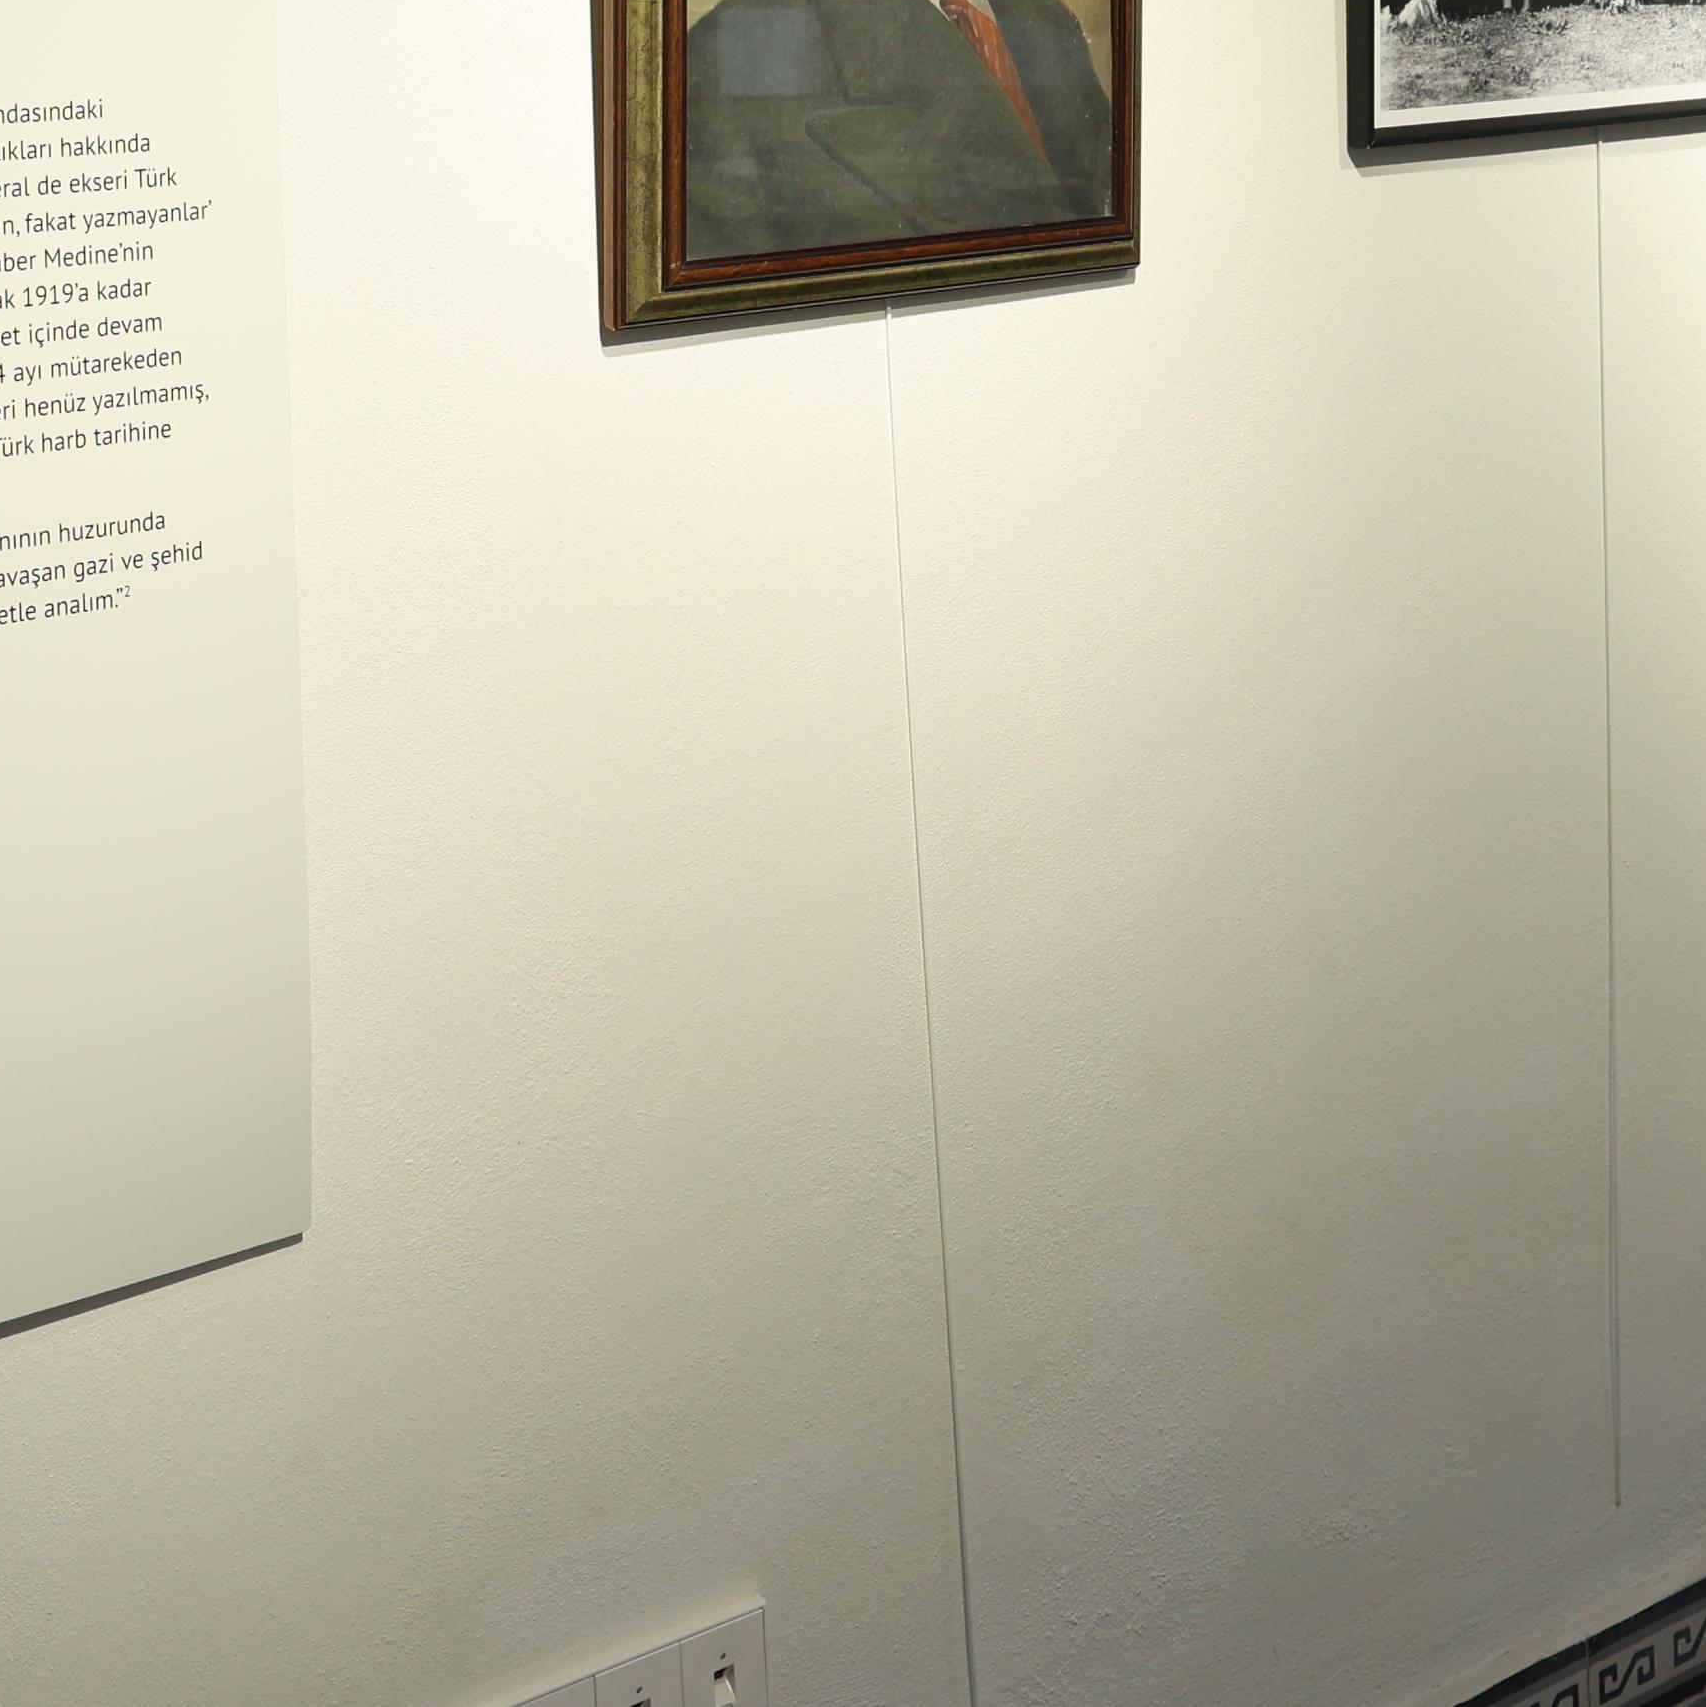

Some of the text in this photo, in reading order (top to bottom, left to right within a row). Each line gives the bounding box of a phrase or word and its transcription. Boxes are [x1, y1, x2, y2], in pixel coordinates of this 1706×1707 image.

[24, 211, 77, 234] fakat
[81, 199, 212, 235] yazmayanlar’
[22, 282, 89, 308] 1919’a
[96, 277, 152, 301] kadar
[40, 428, 87, 453] harb
[92, 420, 172, 447] tarihine
